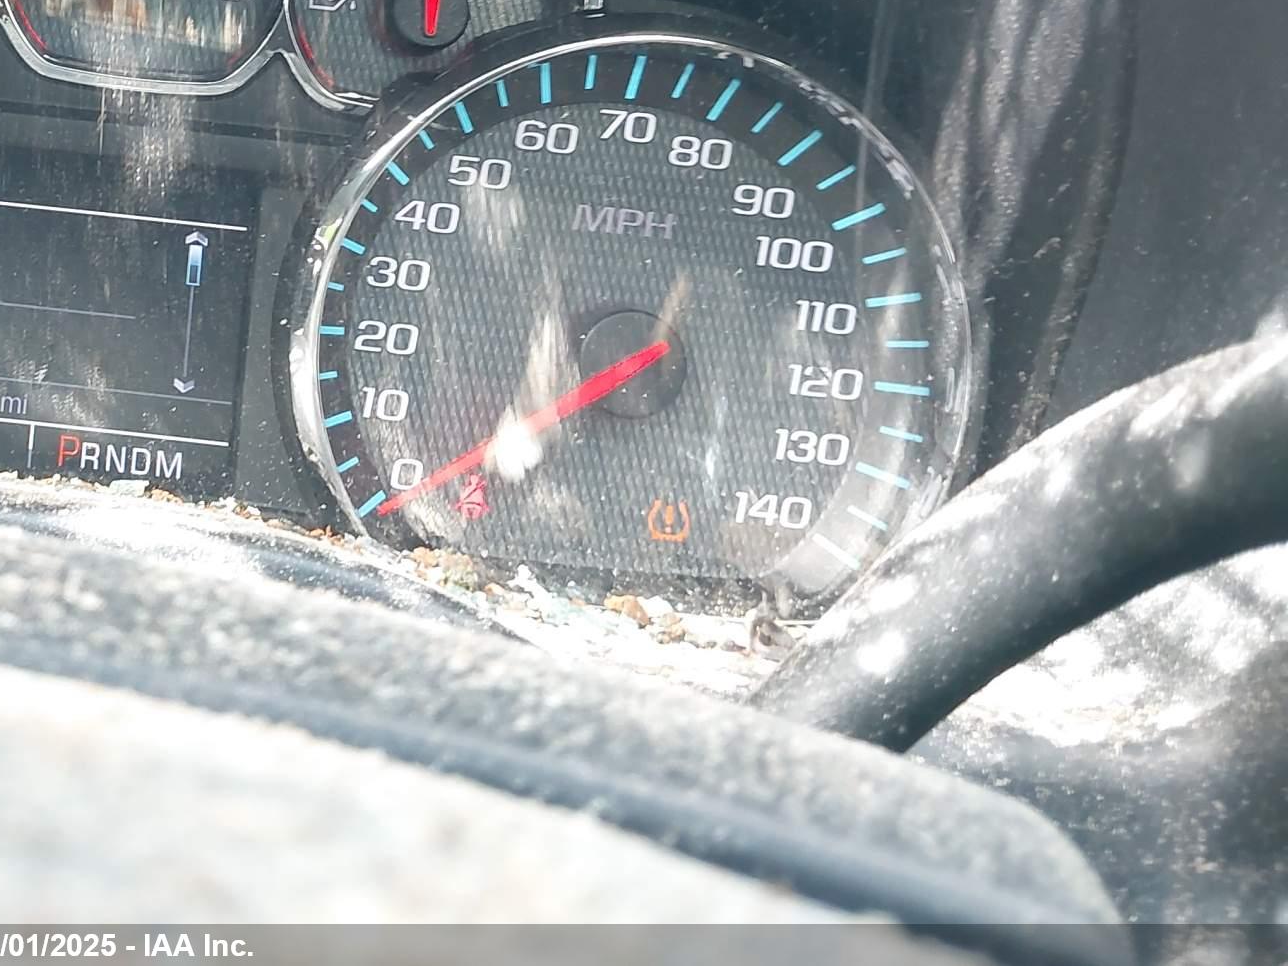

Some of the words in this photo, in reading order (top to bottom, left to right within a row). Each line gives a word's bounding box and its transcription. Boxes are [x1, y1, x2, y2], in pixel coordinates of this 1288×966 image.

[514, 120, 579, 155] 60
[599, 109, 657, 144] 70
[668, 135, 733, 171] 80
[447, 155, 512, 190] 50
[394, 200, 460, 234] 40
[732, 185, 795, 220] 90
[571, 204, 678, 241] MPH
[755, 236, 834, 274] 100
[366, 256, 431, 291] 30
[795, 299, 857, 335] 110
[354, 320, 419, 355] 20
[787, 364, 863, 401] 120
[0, 394, 29, 416] mi
[361, 387, 410, 422] 10
[57, 434, 184, 481] PRNDM
[774, 429, 850, 465] 130
[390, 458, 424, 491] 0
[734, 492, 813, 529] 140
